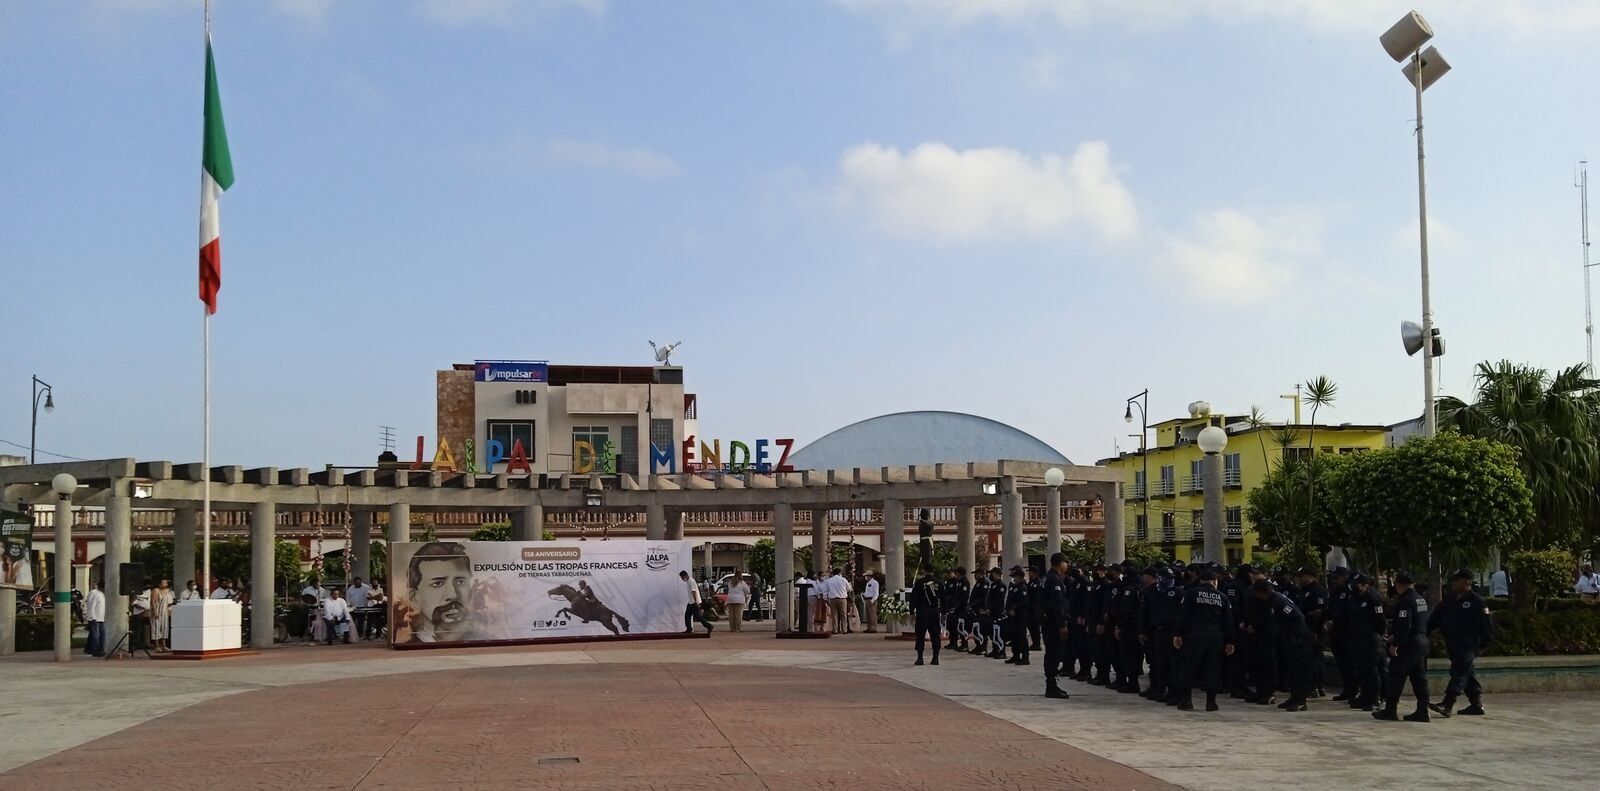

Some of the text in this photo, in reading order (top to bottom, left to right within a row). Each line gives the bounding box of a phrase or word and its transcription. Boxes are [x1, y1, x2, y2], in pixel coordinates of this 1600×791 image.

[410, 435, 794, 474] JALPA DE MÉNDEZ
[535, 550, 578, 558] ANIVERSARIO
[645, 553, 670, 563] JALPA
[474, 561, 638, 572] EXPULSIÓN DE LAS TROPAS FRANCESAS
